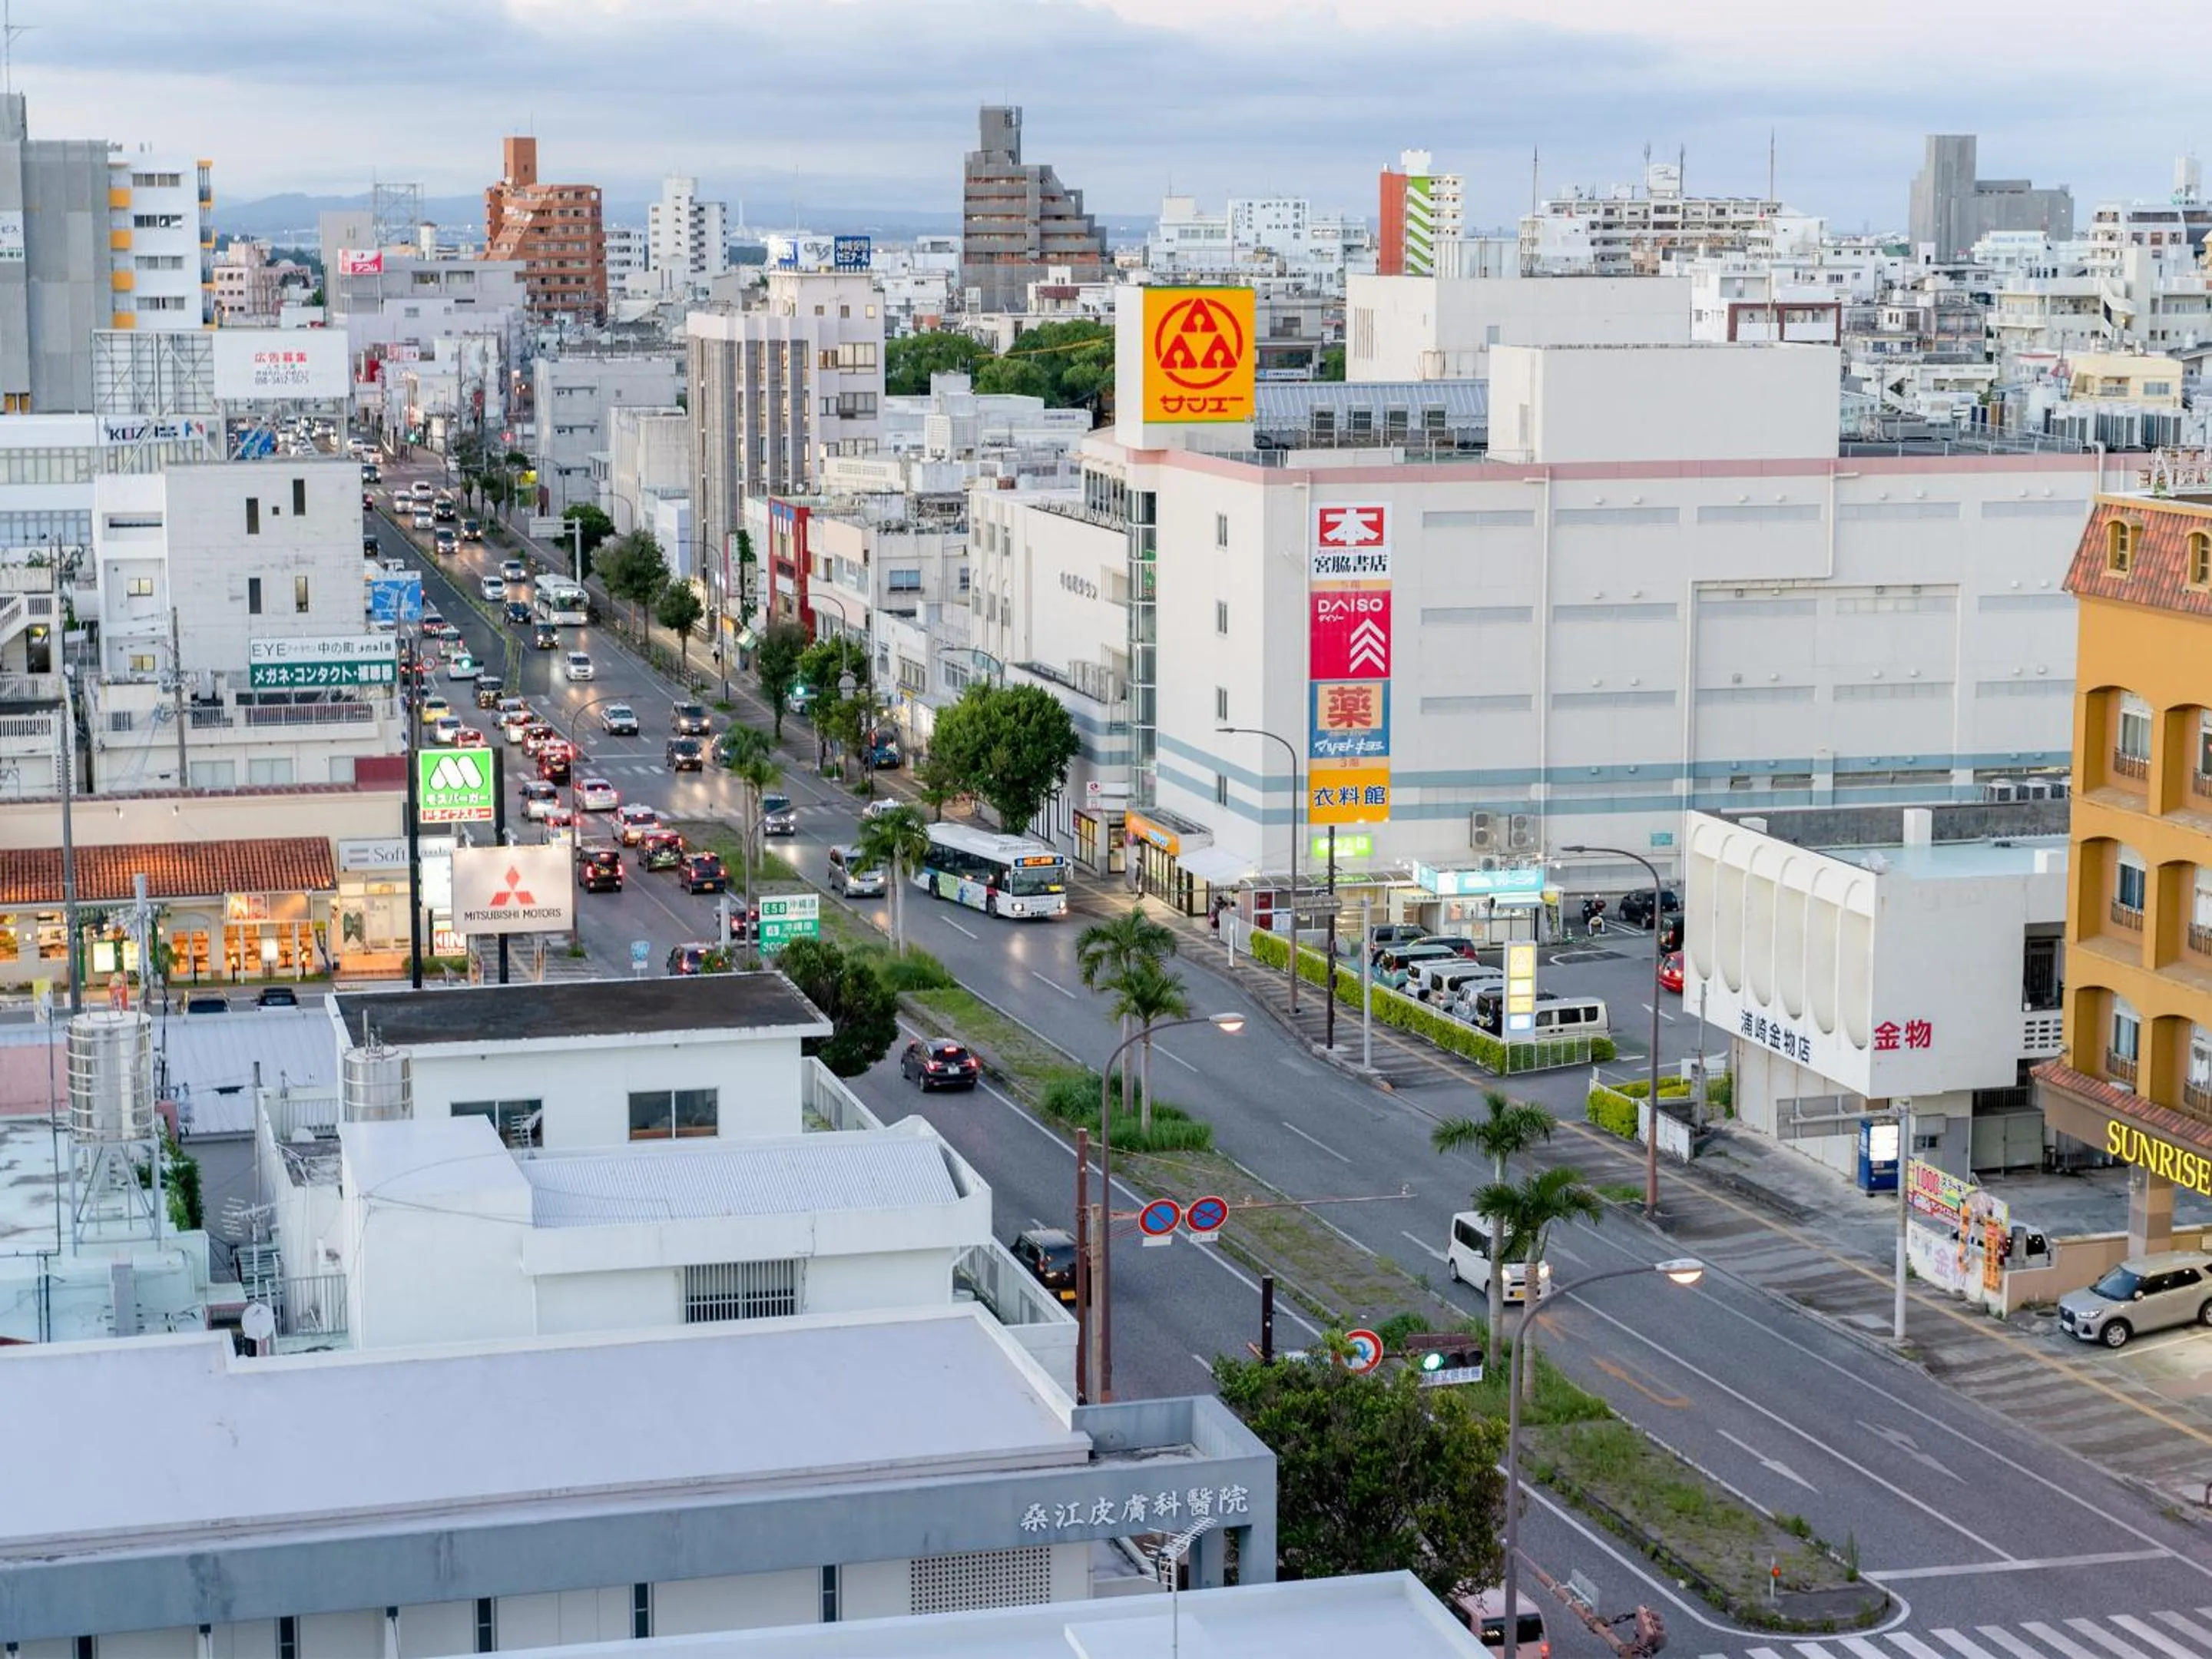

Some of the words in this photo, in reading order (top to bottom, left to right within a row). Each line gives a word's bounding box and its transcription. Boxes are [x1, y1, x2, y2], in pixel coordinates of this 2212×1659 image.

[1160, 395, 1244, 413] サンエー
[1324, 508, 1379, 545] 本
[1315, 555, 1386, 573] 宮脇書店
[1318, 598, 1383, 613] DAISO
[252, 643, 286, 657] EYE
[1328, 686, 1372, 727] 薬
[426, 793, 490, 806] モスバーガー
[1314, 786, 1386, 807] 衣料館
[464, 910, 520, 921] MITSUBISHI
[523, 908, 561, 919] MOTORS
[763, 903, 785, 913] E58
[1874, 1018, 1932, 1050] 金物
[2107, 1120, 2212, 1197] SUNRISE
[1020, 1484, 1249, 1532] 桑江皮膚科醫院
